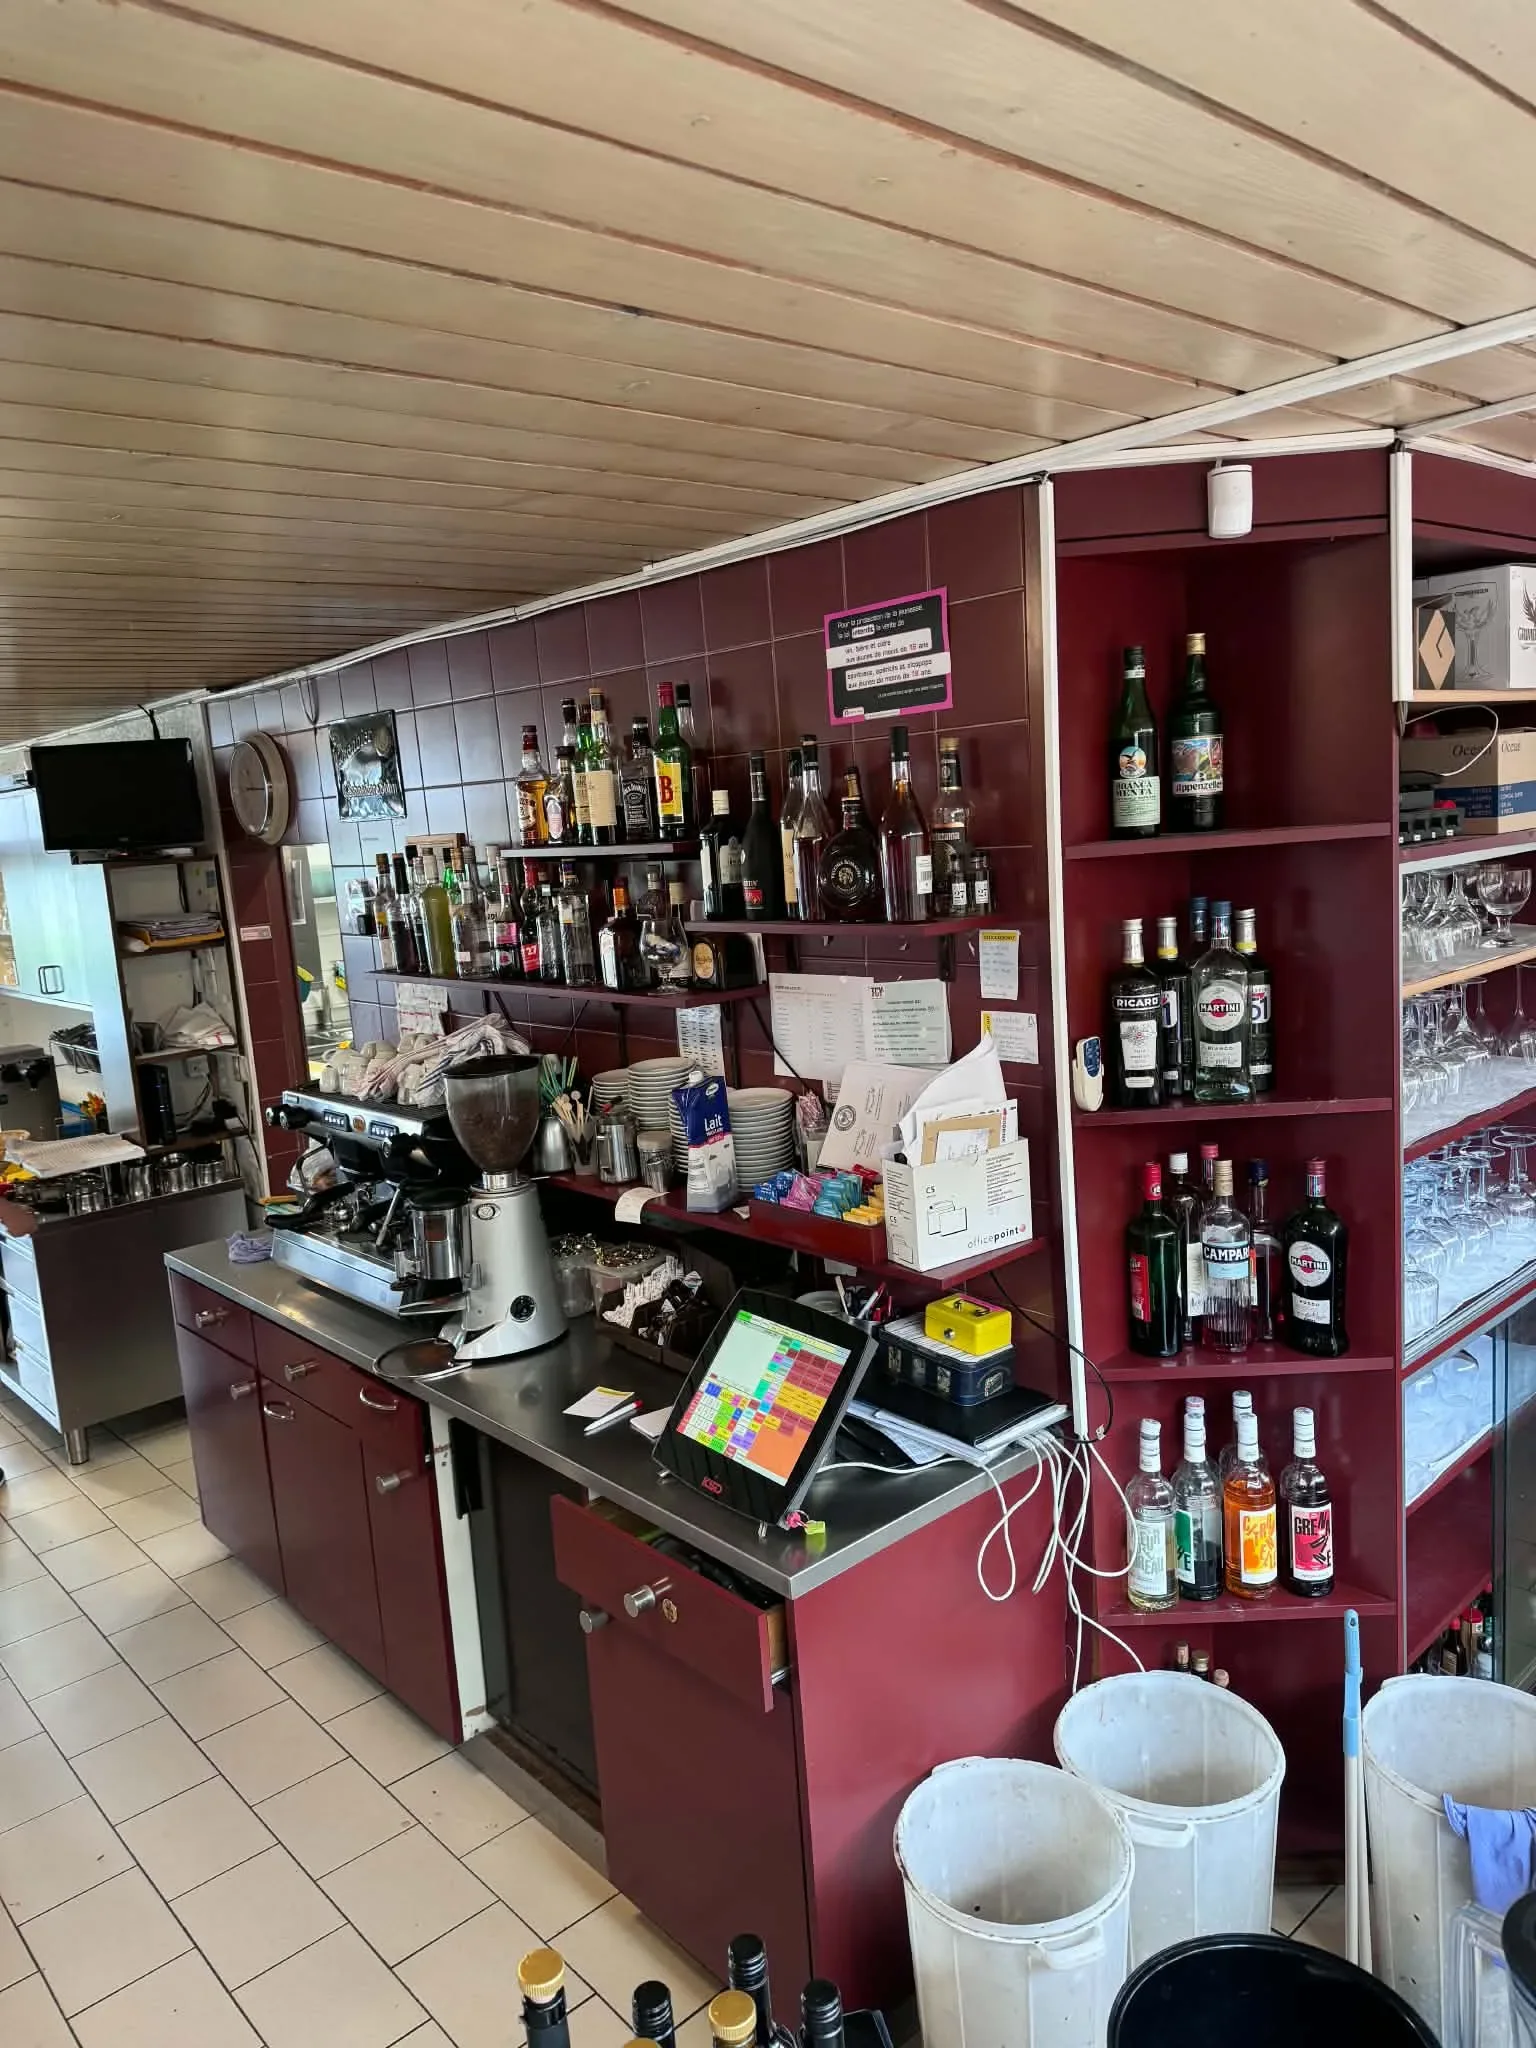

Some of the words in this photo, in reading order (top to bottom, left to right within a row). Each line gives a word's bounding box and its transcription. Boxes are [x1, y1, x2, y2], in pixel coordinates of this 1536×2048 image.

[1116, 997, 1159, 1008] RICARD
[1200, 1004, 1239, 1013] MARTINI
[704, 1113, 723, 1131] Lait
[967, 1226, 1019, 1249] officepoint
[1203, 1246, 1249, 1261] CAMPAR
[1291, 1256, 1328, 1270] MARTINI
